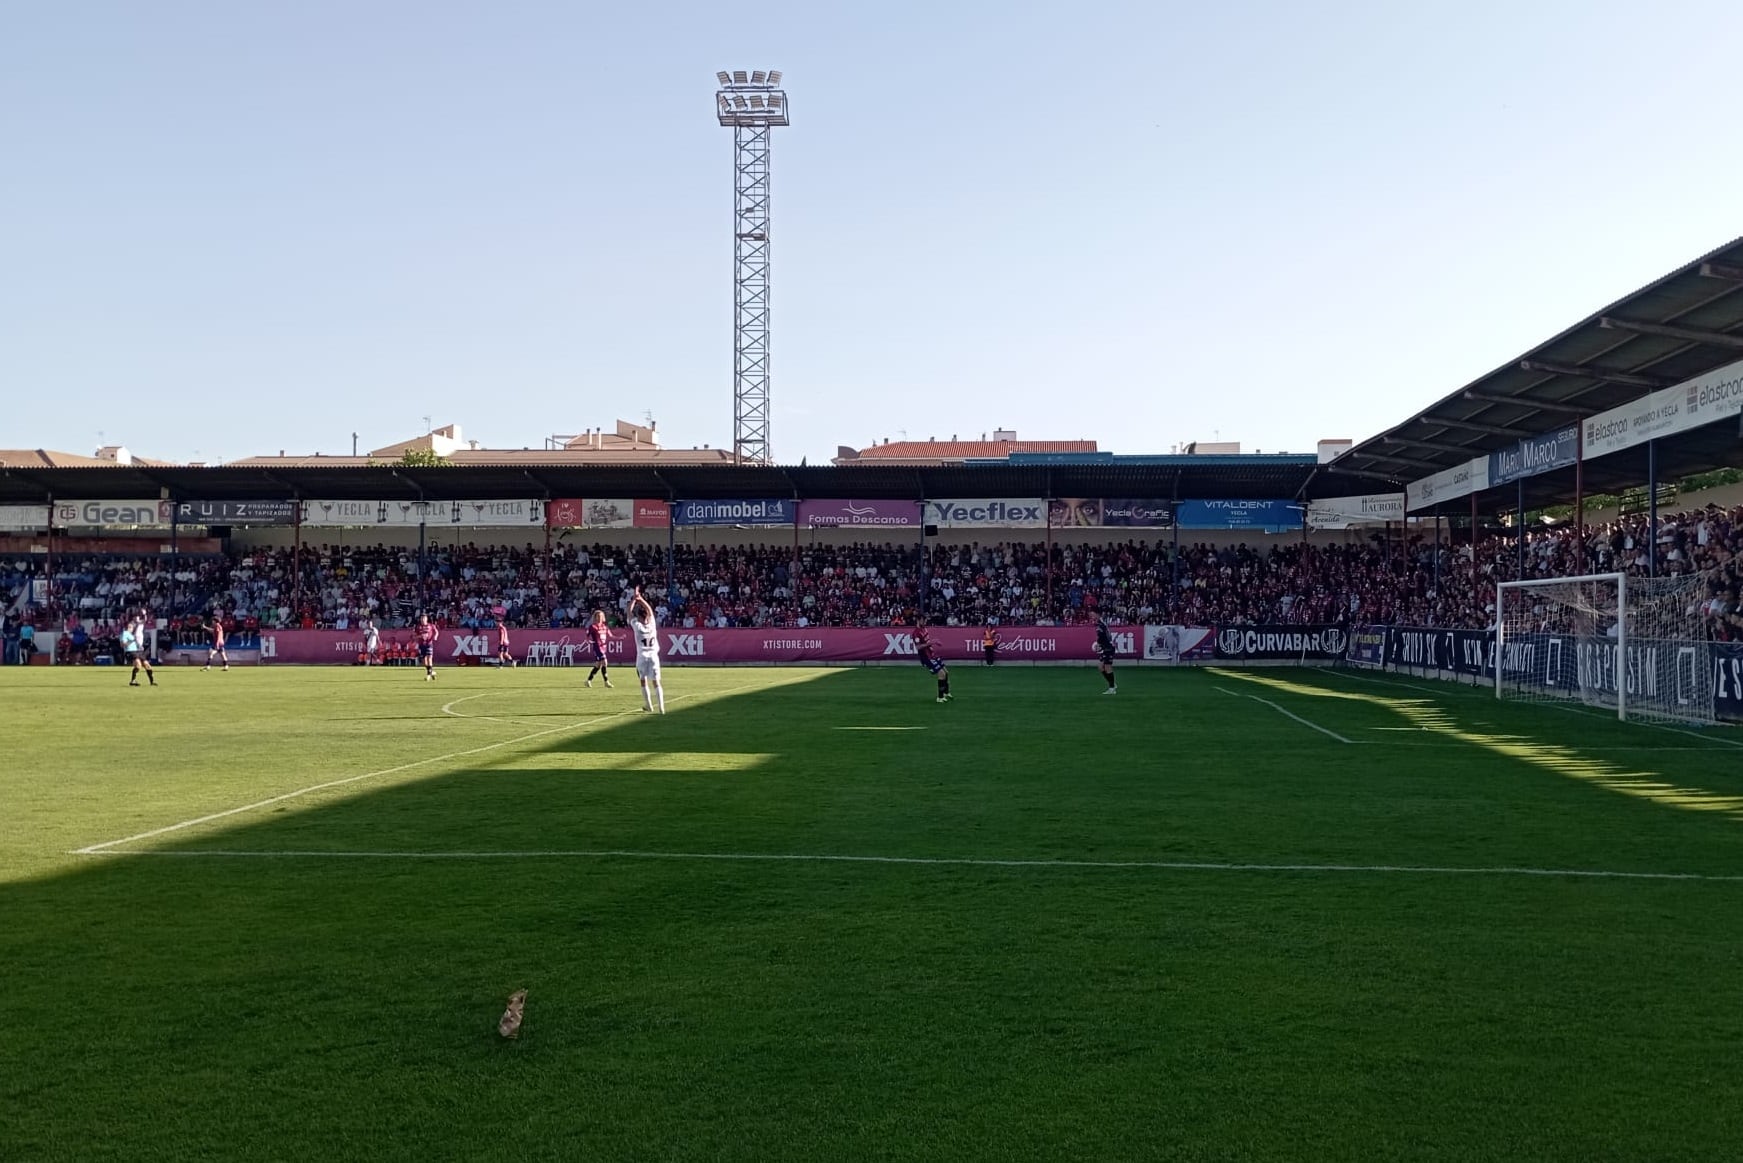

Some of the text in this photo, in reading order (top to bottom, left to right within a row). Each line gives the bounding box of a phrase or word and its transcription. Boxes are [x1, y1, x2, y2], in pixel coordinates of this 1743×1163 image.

[1661, 404, 1679, 418] YECLA
[1595, 417, 1628, 441] elastron
[1523, 439, 1557, 469] MARCO
[83, 502, 154, 523] Gean
[337, 503, 371, 516] YECLA
[489, 502, 523, 515] YECLA
[687, 501, 766, 518] danimobel
[934, 502, 1039, 521] Yecflex
[1204, 501, 1273, 509] VITALDENT
[1368, 502, 1402, 513] AURORA
[809, 514, 908, 525] Formas Descanso
[452, 634, 488, 656] Xti
[668, 634, 704, 656] Xti
[763, 639, 822, 649] XTISTORE.COM
[1019, 639, 1056, 652] TOUCH
[1245, 630, 1320, 653] CURVABAR
